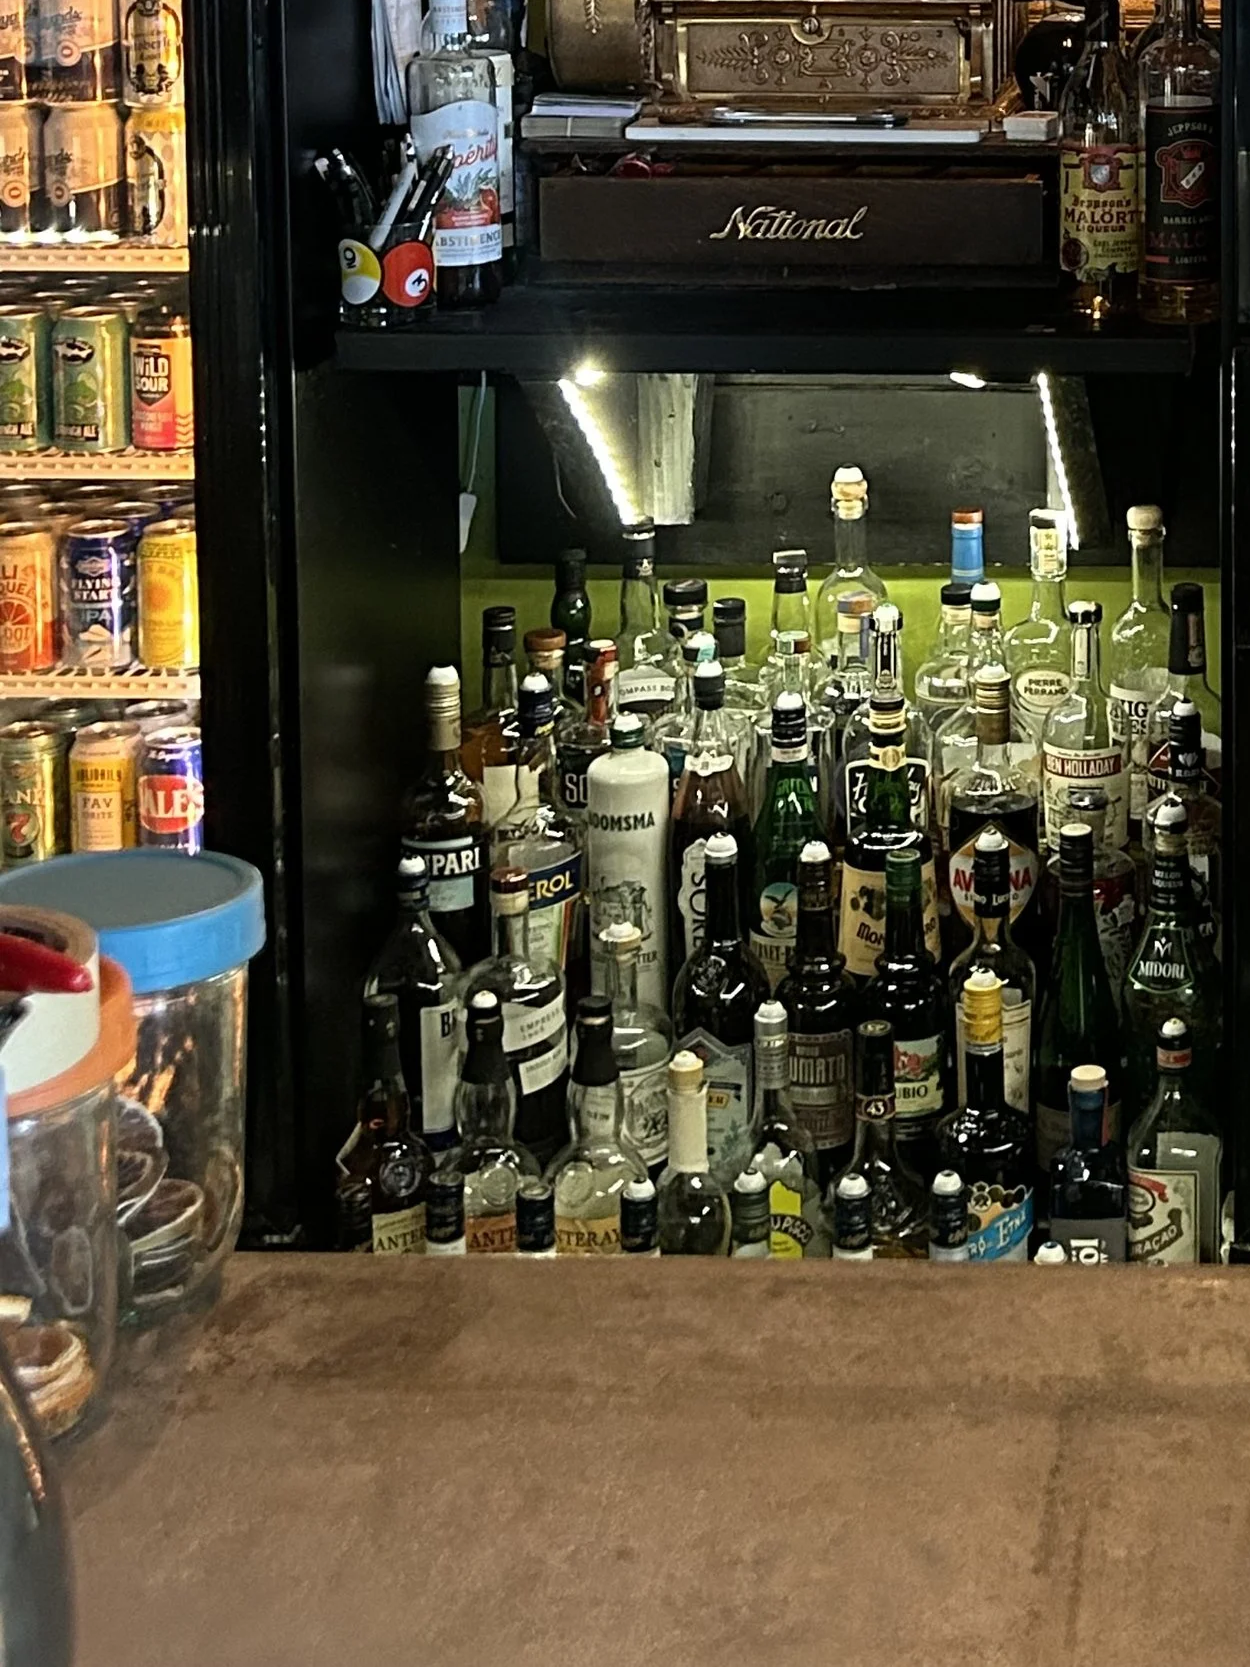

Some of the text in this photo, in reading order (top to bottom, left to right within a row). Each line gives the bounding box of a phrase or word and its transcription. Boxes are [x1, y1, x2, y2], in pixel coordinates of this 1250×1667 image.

[710, 204, 869, 242] National
[135, 377, 169, 393] SOUR
[71, 578, 121, 590] FLYIN
[1063, 754, 1116, 777] HOLLADAY
[424, 848, 482, 876] PARI
[952, 866, 1033, 894] AVNA
[1137, 958, 1186, 980] MIDORI
[865, 1100, 886, 1115] 43
[556, 1229, 621, 1247] NTERAY
